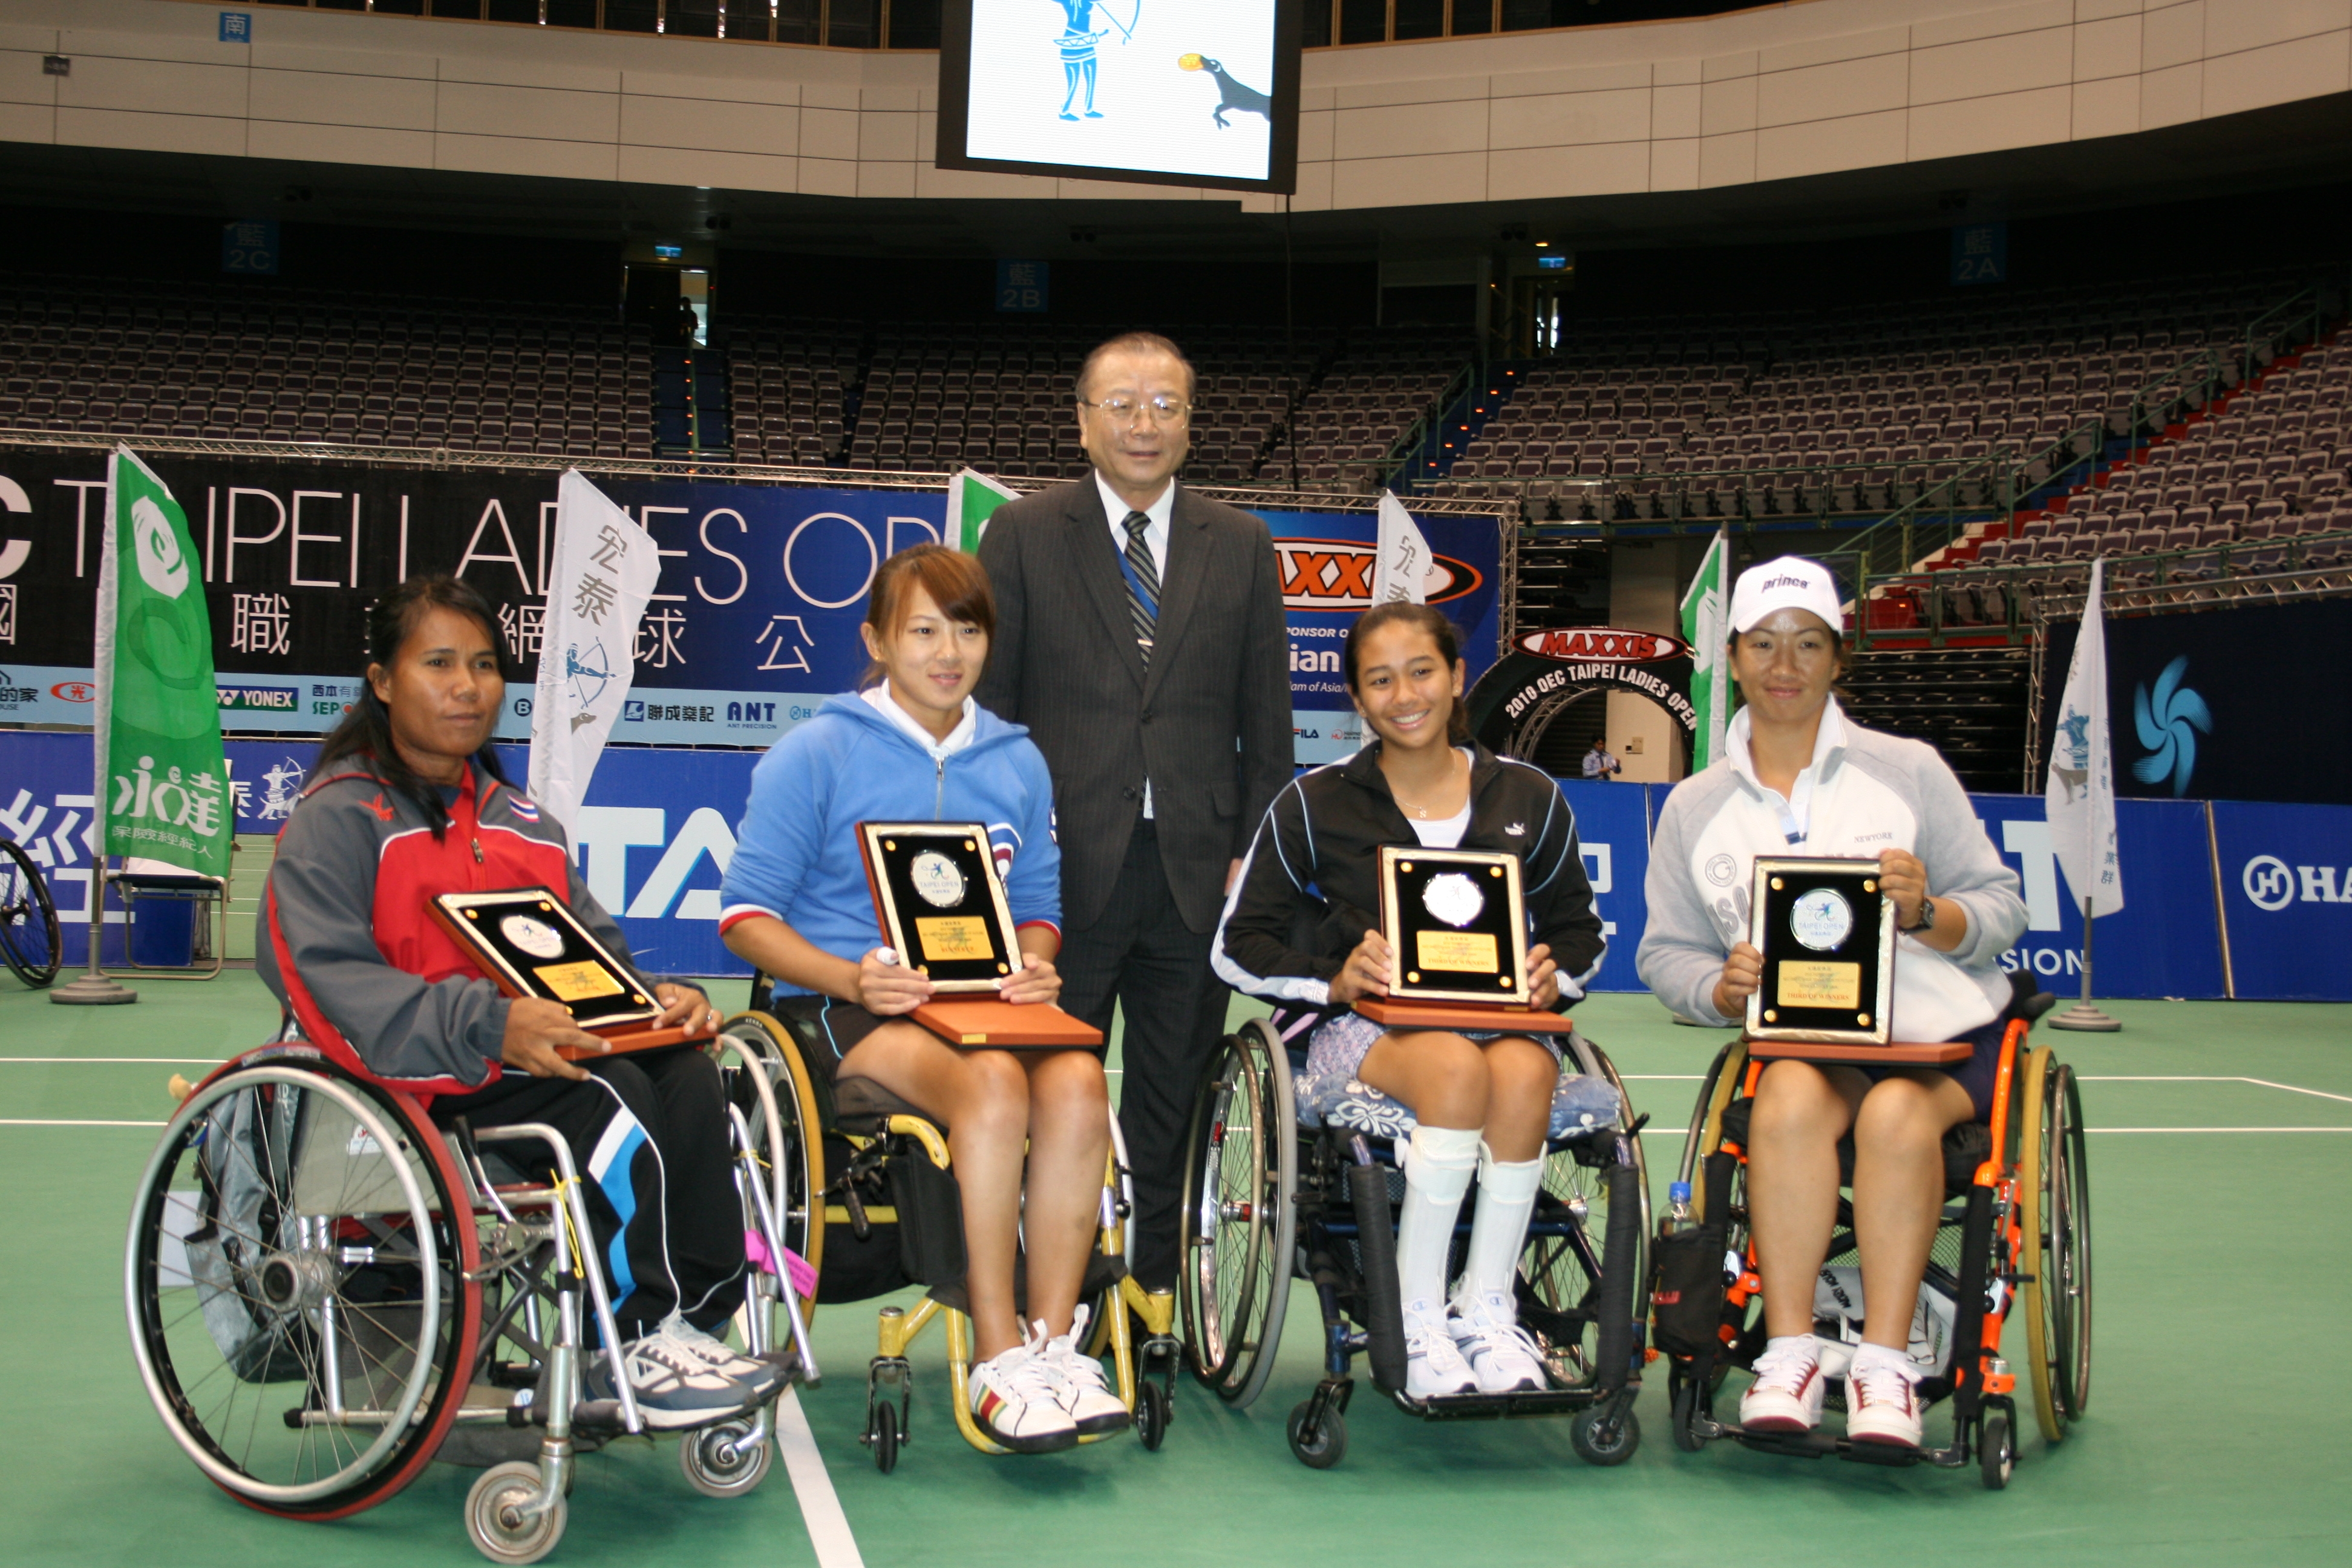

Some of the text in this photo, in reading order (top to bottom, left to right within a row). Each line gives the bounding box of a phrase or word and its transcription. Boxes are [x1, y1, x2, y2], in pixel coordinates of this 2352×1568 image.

[224, 15, 246, 35] 南
[229, 249, 271, 270] 2C
[1957, 256, 1999, 281] 2A
[1002, 289, 1041, 309] 2B
[54, 479, 360, 589] TIPEI
[1761, 573, 1809, 593] prince
[1538, 632, 1658, 659] MAXXIS
[242, 690, 293, 707] YONEX
[1505, 664, 1698, 731] 2010 OEC TAIPEI LADIES OPEN
[727, 702, 776, 722] ANT
[1293, 728, 1319, 739] FILA
[112, 825, 214, 859] 保險經紀人
